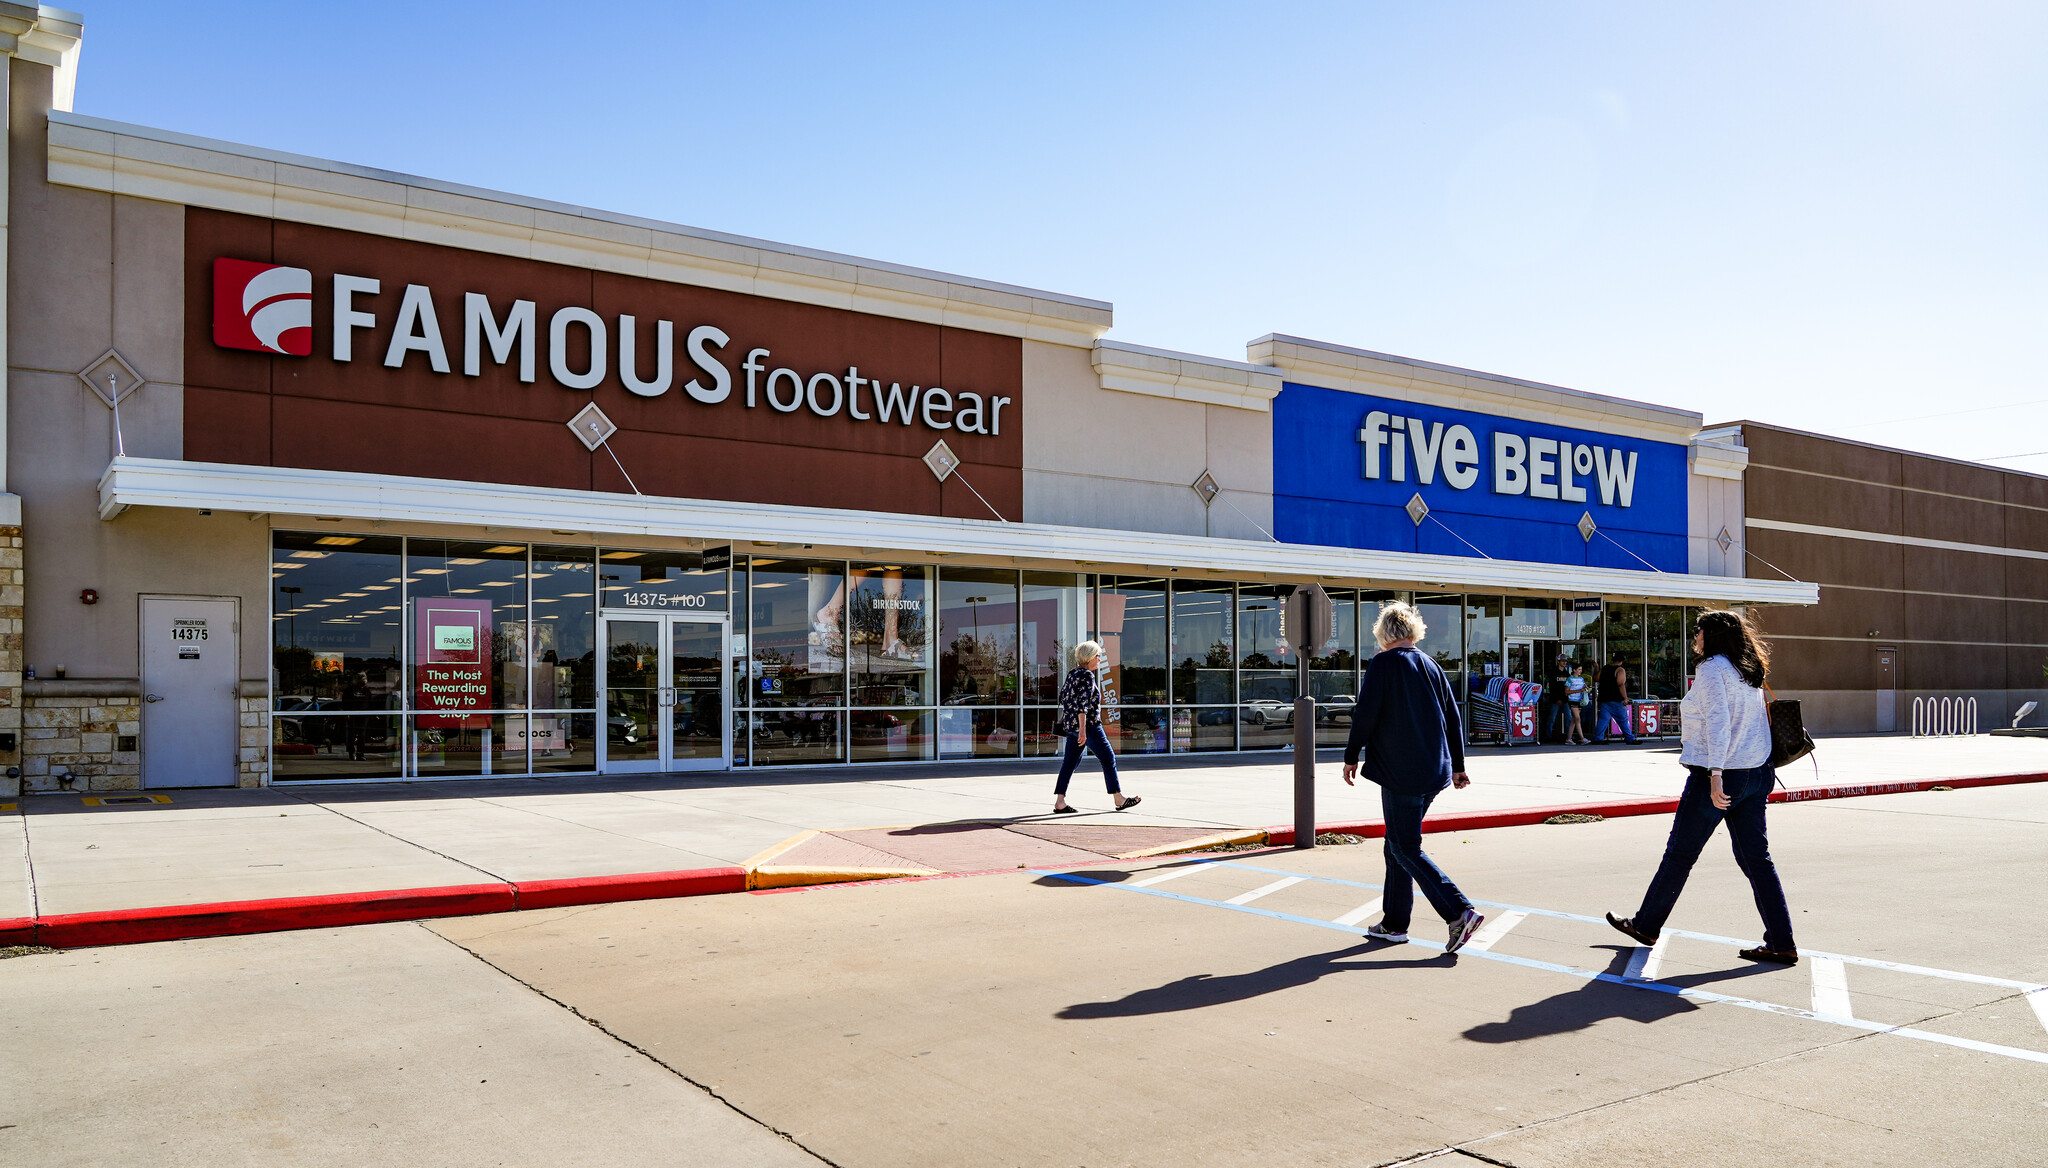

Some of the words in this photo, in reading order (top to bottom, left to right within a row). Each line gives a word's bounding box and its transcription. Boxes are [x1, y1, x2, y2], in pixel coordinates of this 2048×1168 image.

[332, 271, 733, 404] FAMOUS
[742, 347, 1012, 436] footwear
[623, 592, 667, 606] 14375
[671, 594, 706, 608] #100
[873, 599, 920, 610] BIRKENSTOCK
[1278, 594, 1286, 637] checkout
[172, 629, 208, 640] 14375
[1517, 625, 1532, 633] 14375
[443, 637, 471, 645] FAMOUS
[427, 670, 449, 680] The
[453, 670, 482, 680] Most
[422, 683, 487, 695] Rewarding
[433, 696, 461, 708] Way
[464, 696, 477, 705] to
[1514, 711, 1534, 736] $5
[1640, 709, 1657, 733] $5
[518, 730, 552, 738] cocs
[1786, 791, 1802, 801] FIRE
[1803, 789, 1822, 799] LANE
[1828, 787, 1838, 797] NO
[1839, 785, 1868, 796] PARKING
[1902, 782, 1919, 791] ZONE
